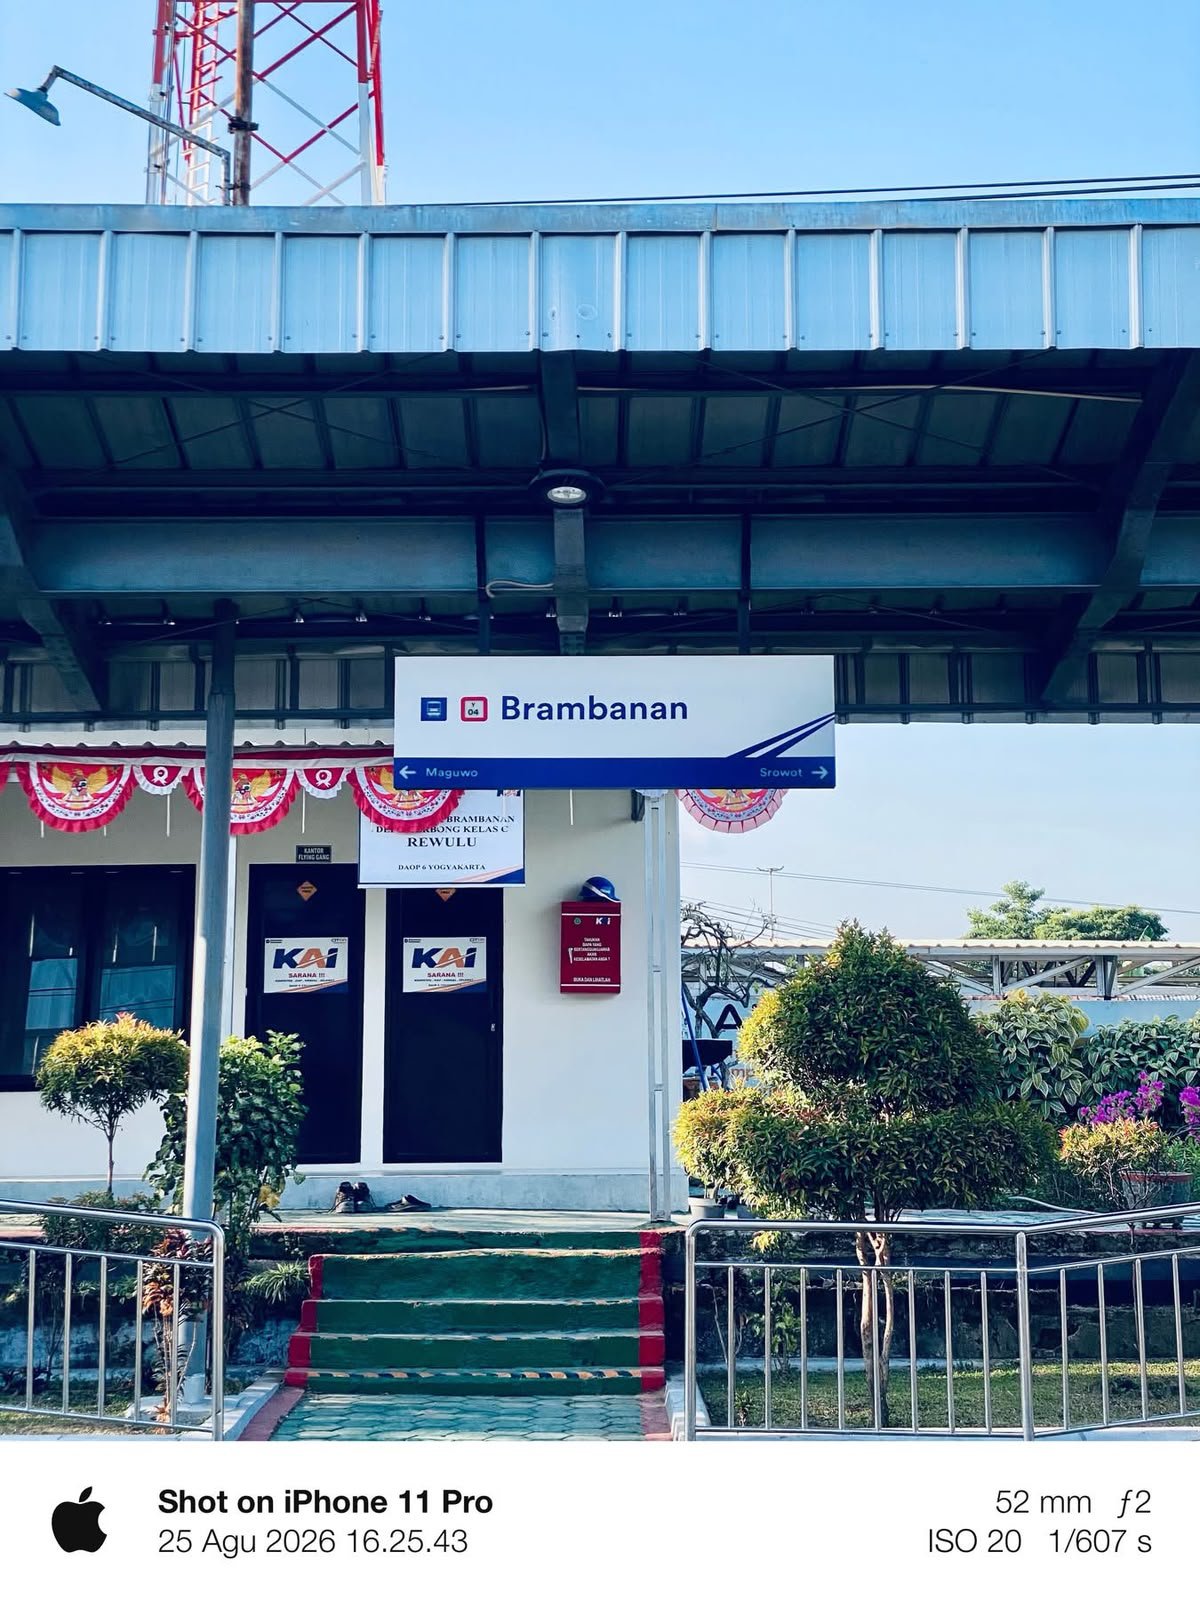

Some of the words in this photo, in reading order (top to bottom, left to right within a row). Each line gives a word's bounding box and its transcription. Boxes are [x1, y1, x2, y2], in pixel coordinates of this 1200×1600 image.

[467, 708, 479, 716] 04
[501, 695, 688, 721] Brambanan
[425, 767, 479, 779] Maguwo
[759, 767, 803, 777] Srowot
[446, 815, 515, 823] BRAMBANAN
[463, 825, 499, 833] KELAS
[500, 825, 509, 833] C
[407, 837, 478, 848] REWULU
[272, 947, 339, 969] KAI
[411, 947, 478, 969] KAI
